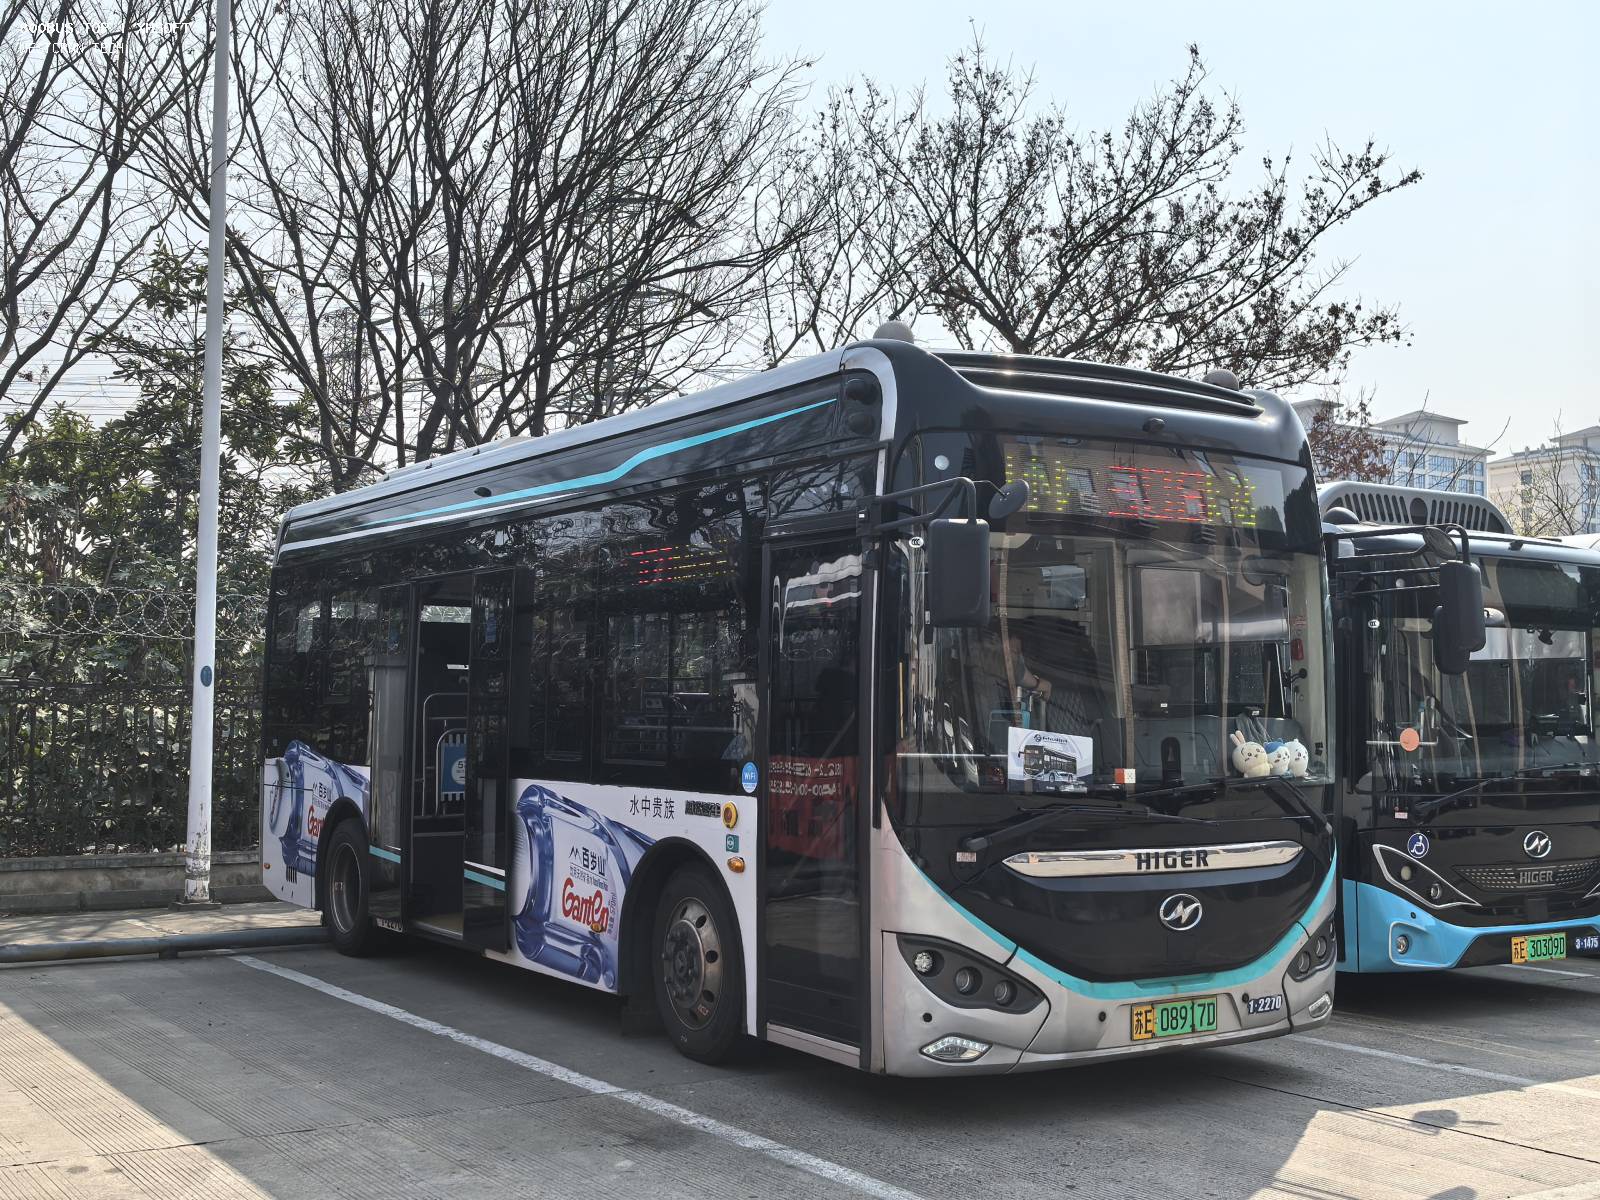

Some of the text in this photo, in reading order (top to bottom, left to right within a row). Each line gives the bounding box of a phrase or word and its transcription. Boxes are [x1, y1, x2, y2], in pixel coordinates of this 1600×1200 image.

[629, 793, 675, 820] 水中贵族
[582, 846, 606, 877] 百岁山
[1136, 849, 1209, 871] HIGER
[1519, 870, 1554, 884] HIGER
